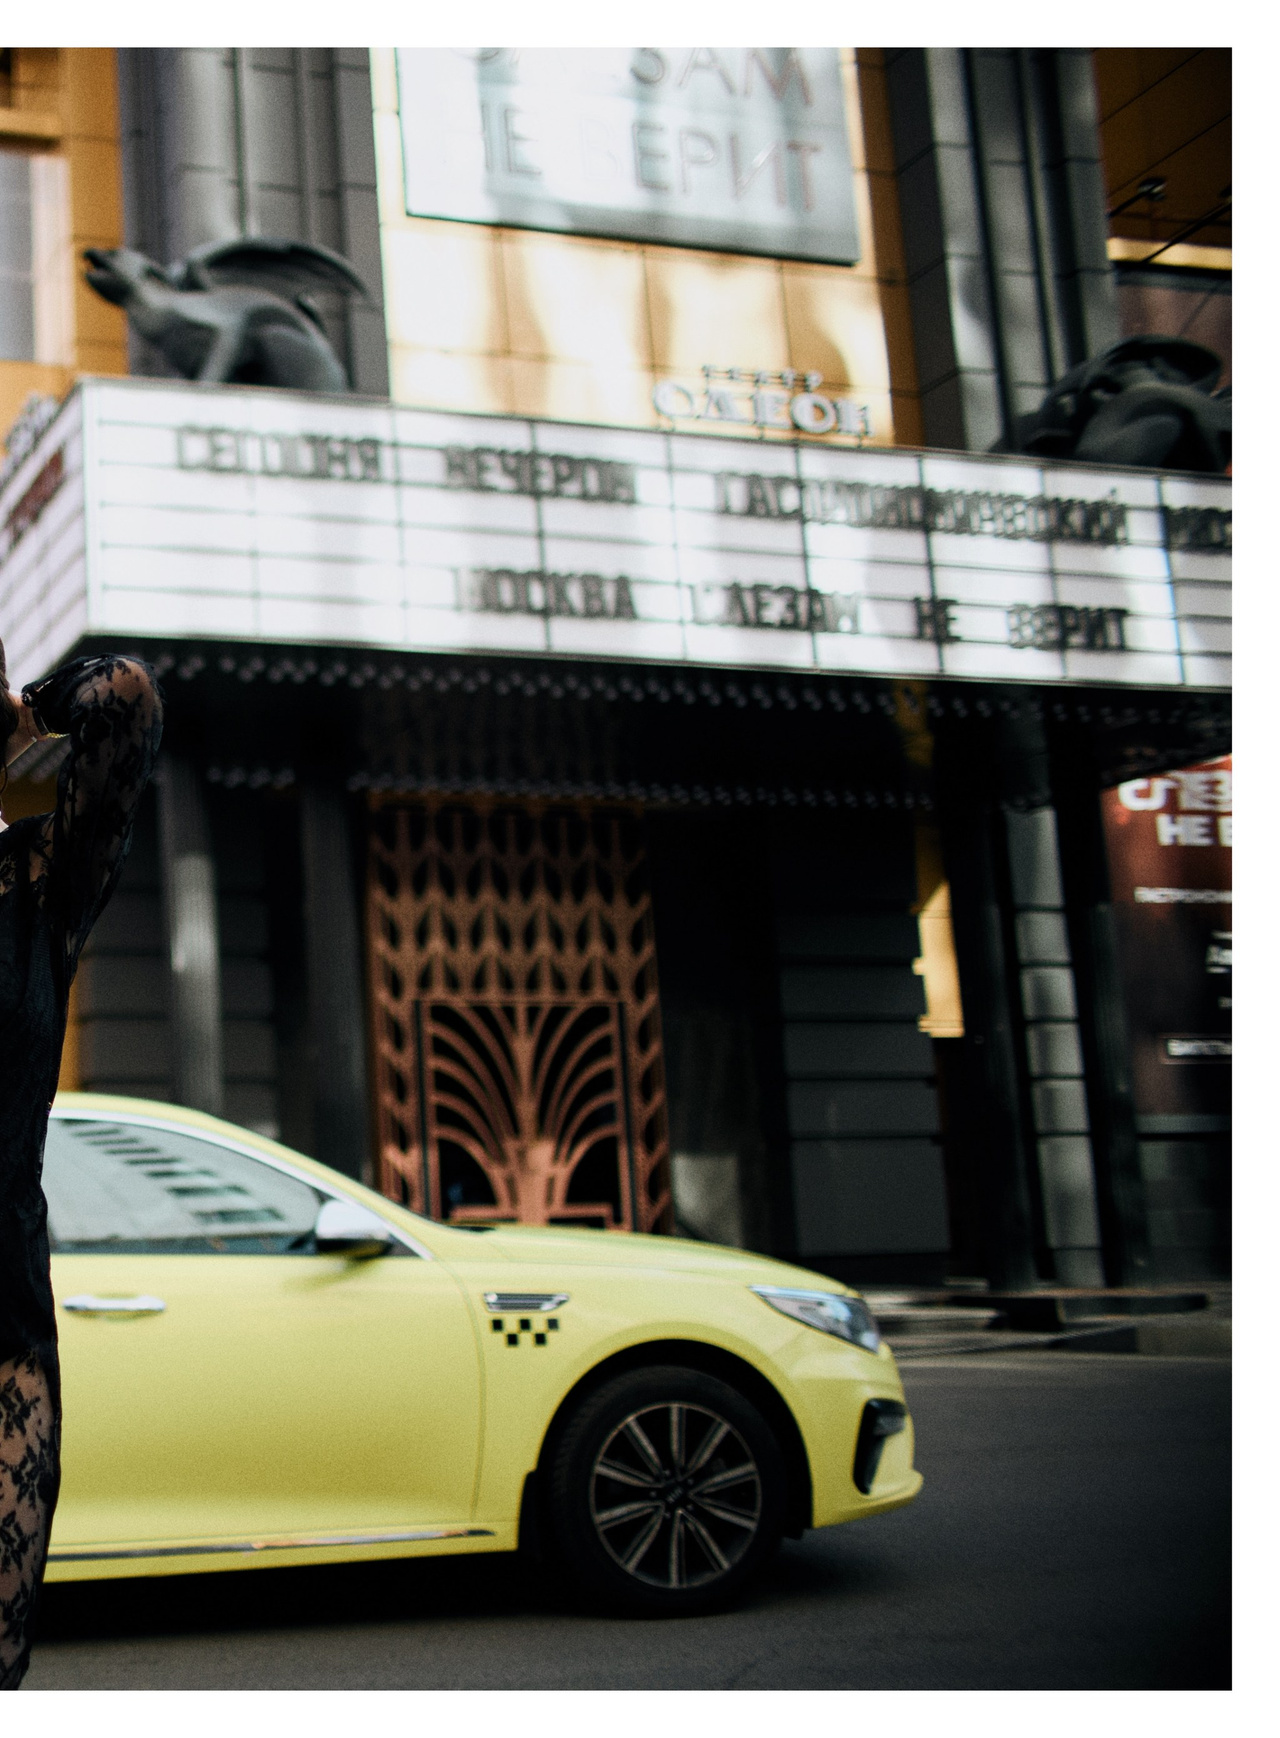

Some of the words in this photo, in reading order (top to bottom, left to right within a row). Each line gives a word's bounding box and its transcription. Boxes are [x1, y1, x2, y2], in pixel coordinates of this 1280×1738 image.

[915, 597, 961, 643] НЕ
[1006, 602, 1128, 652] ВЕРИТ
[1156, 813, 1214, 847] НЕ
